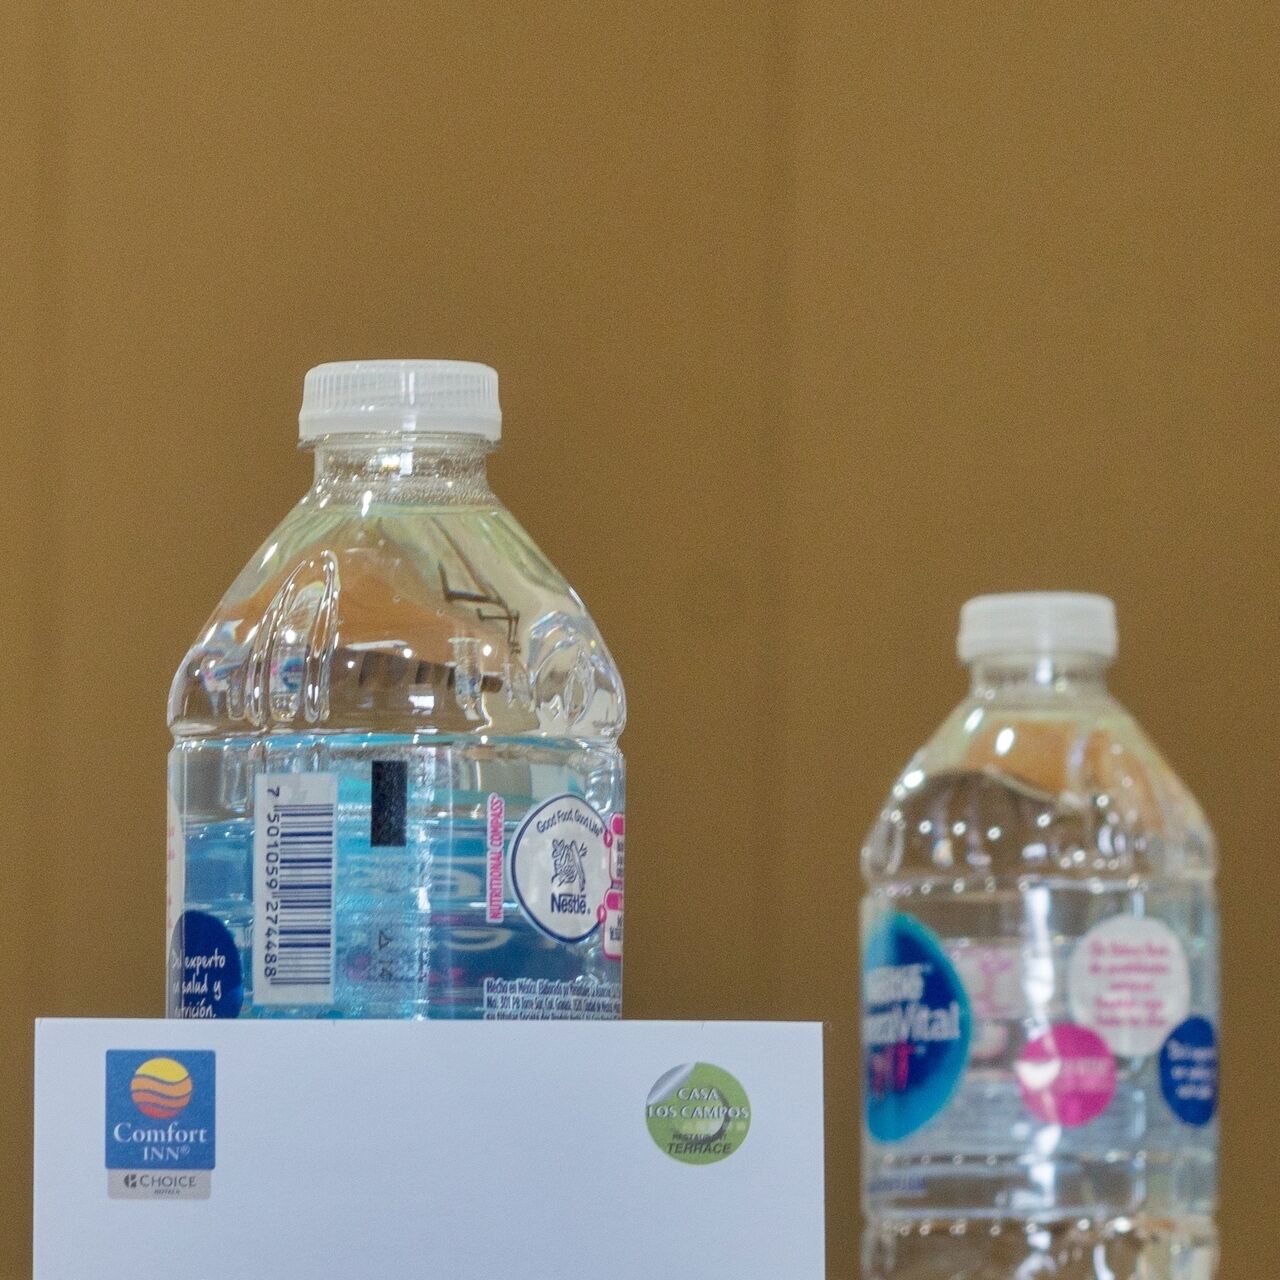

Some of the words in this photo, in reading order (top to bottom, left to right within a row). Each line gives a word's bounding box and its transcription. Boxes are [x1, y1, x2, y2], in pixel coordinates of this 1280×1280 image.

[490, 798, 504, 848] COMPASS
[536, 814, 557, 834] Good
[265, 812, 280, 889] 501059
[489, 851, 504, 919] NUTRITIONAL
[550, 892, 588, 914] Nestlé
[263, 902, 279, 979] 274488
[184, 948, 226, 976] experto
[182, 972, 208, 994] salud
[213, 980, 222, 1001] y
[676, 1087, 719, 1101] CASA
[647, 1105, 677, 1118] LOS
[680, 1105, 749, 1119] CAMPOS
[113, 1120, 208, 1143] Comfort
[139, 1174, 197, 1188] CHOICE
